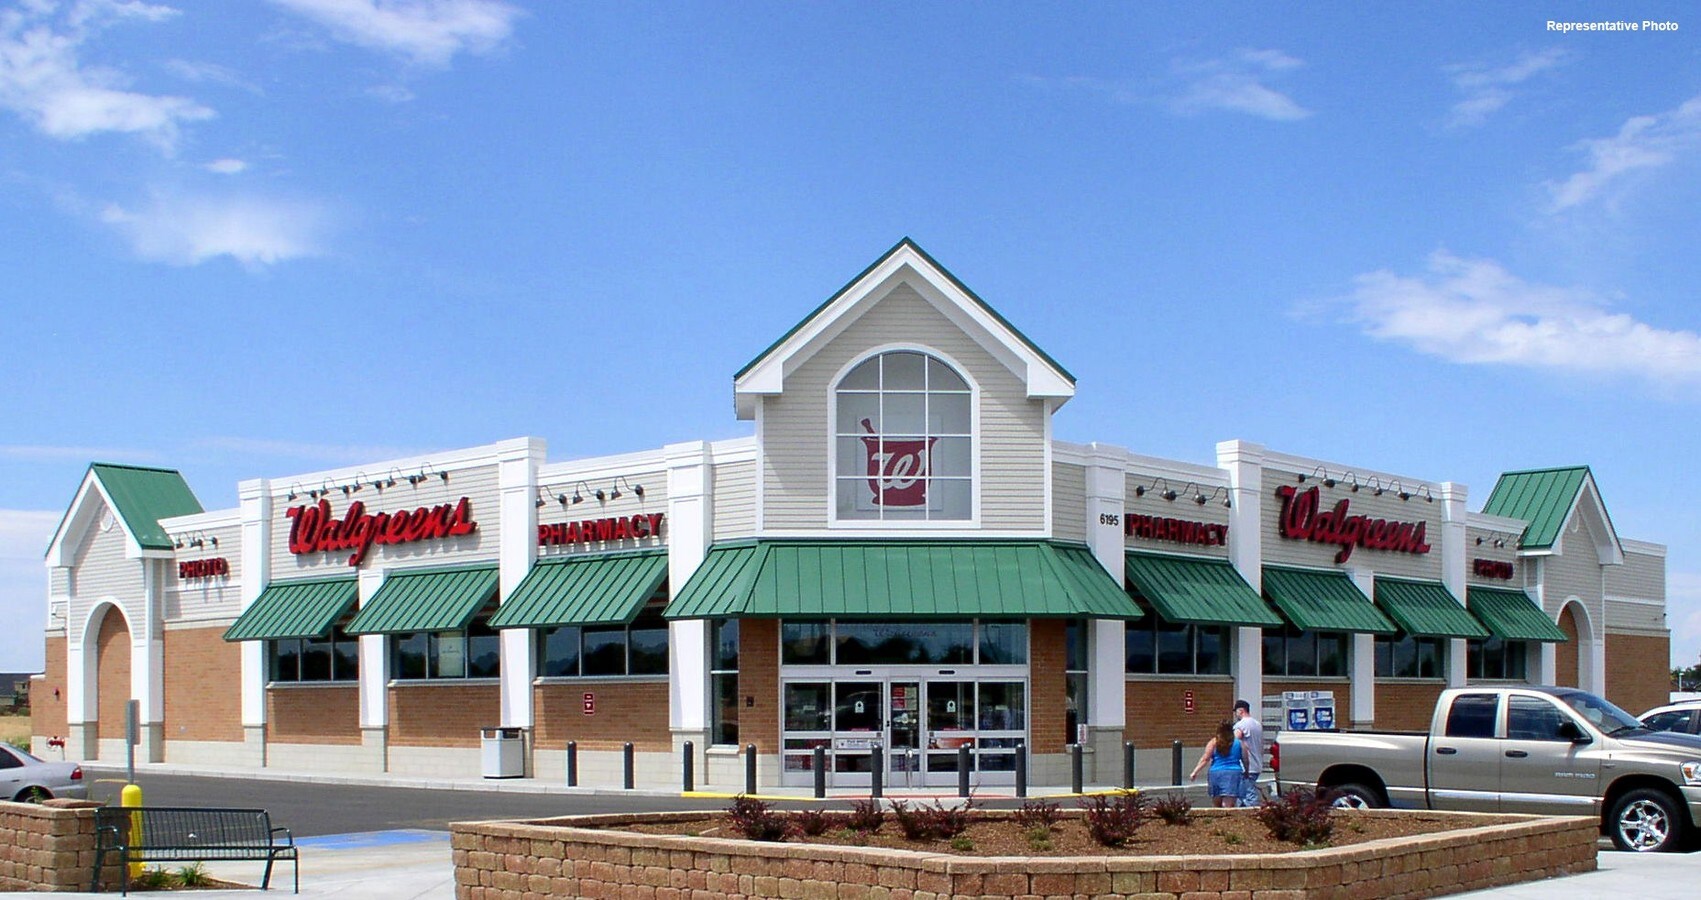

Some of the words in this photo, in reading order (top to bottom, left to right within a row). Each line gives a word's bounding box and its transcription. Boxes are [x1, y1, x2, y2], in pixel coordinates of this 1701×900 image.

[286, 497, 478, 566] Walgreens
[538, 513, 664, 546] PHARMACY
[1100, 513, 1119, 526] 6195
[1124, 513, 1229, 546] PHARMACY
[1275, 485, 1431, 564] Walgreens
[179, 557, 228, 578] PHOTO
